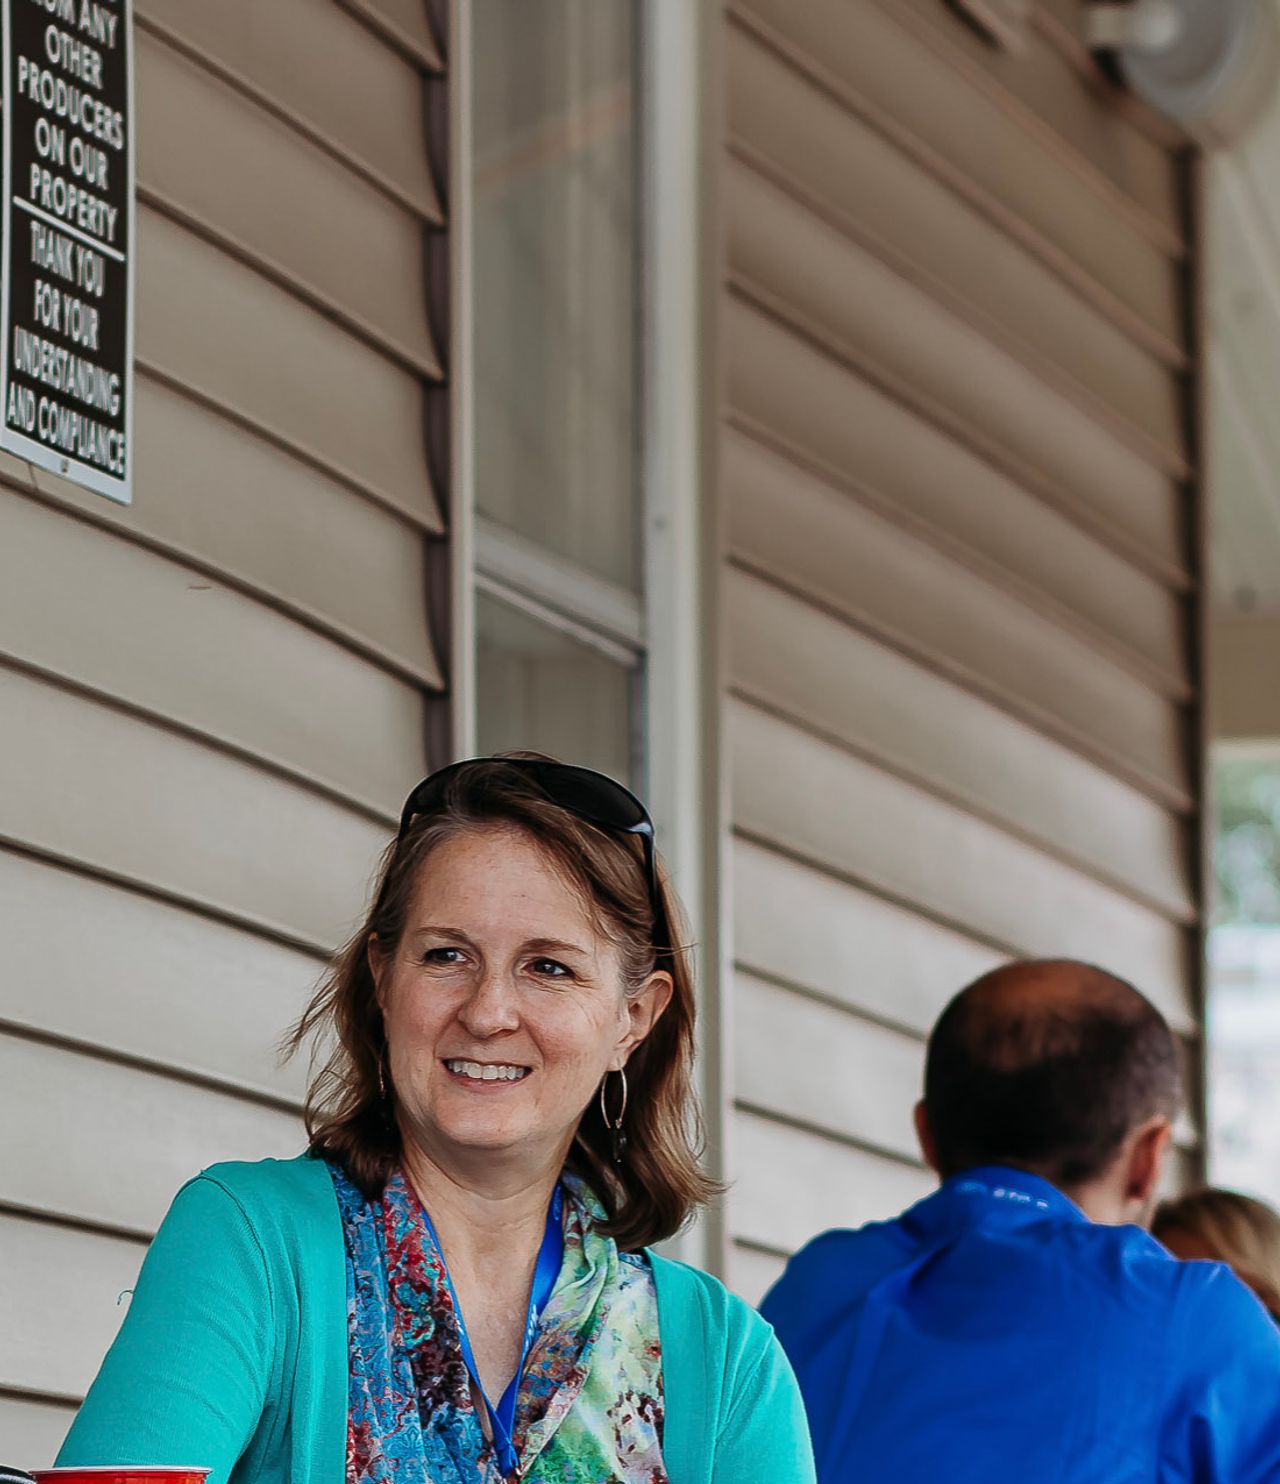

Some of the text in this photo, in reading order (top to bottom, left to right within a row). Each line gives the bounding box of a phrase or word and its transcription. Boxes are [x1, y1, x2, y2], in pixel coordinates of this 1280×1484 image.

[45, 24, 103, 89] OTHER
[78, 0, 118, 49] ANY
[17, 55, 123, 150] PRODUCERS
[35, 117, 109, 191] ON OUR
[30, 162, 118, 242] PROPERTY
[30, 220, 105, 298] THANK YOU
[34, 279, 99, 350] FOR YOUR
[14, 324, 121, 417] UNDERSTANDING
[7, 381, 126, 474] AND COMPLIANCE
